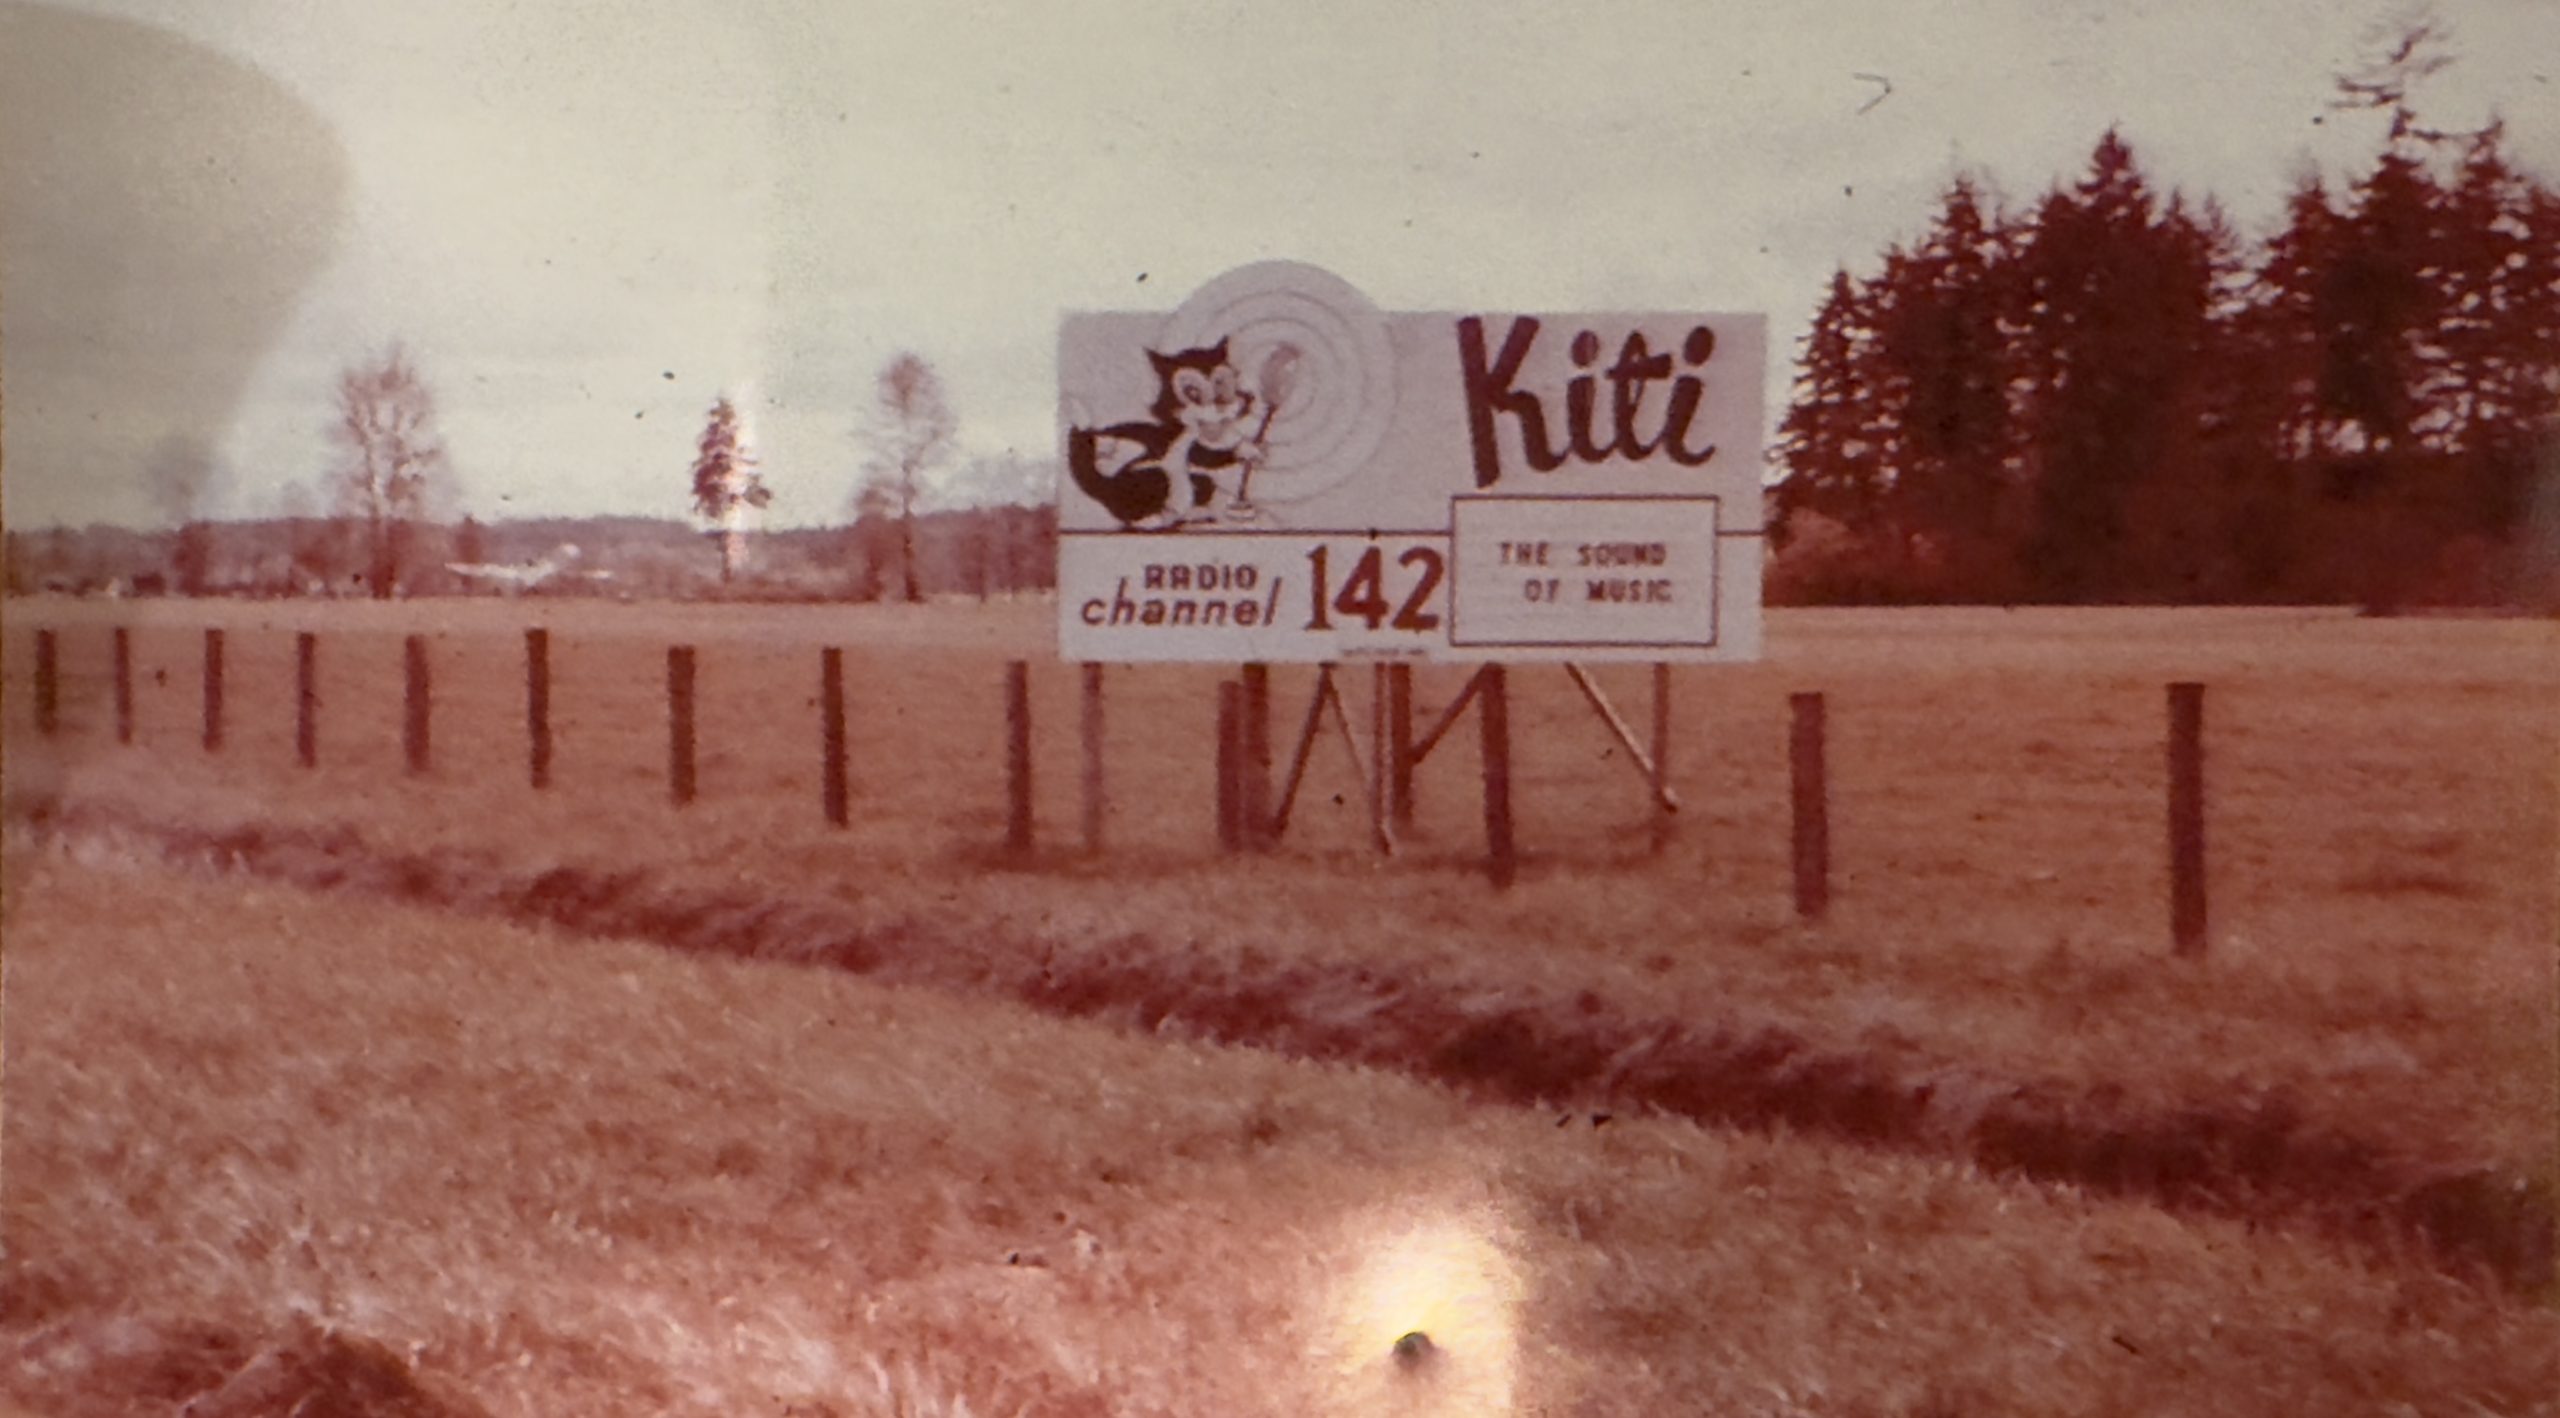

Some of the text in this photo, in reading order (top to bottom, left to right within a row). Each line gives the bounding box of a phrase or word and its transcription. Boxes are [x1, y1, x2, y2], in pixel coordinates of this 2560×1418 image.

[1456, 315, 1717, 489] Kiti
[1498, 541, 1667, 568] THE SOUND
[1080, 544, 1446, 634] channel 142
[1143, 563, 1259, 592] RADIO
[1523, 579, 1673, 605] OF MUSIC
